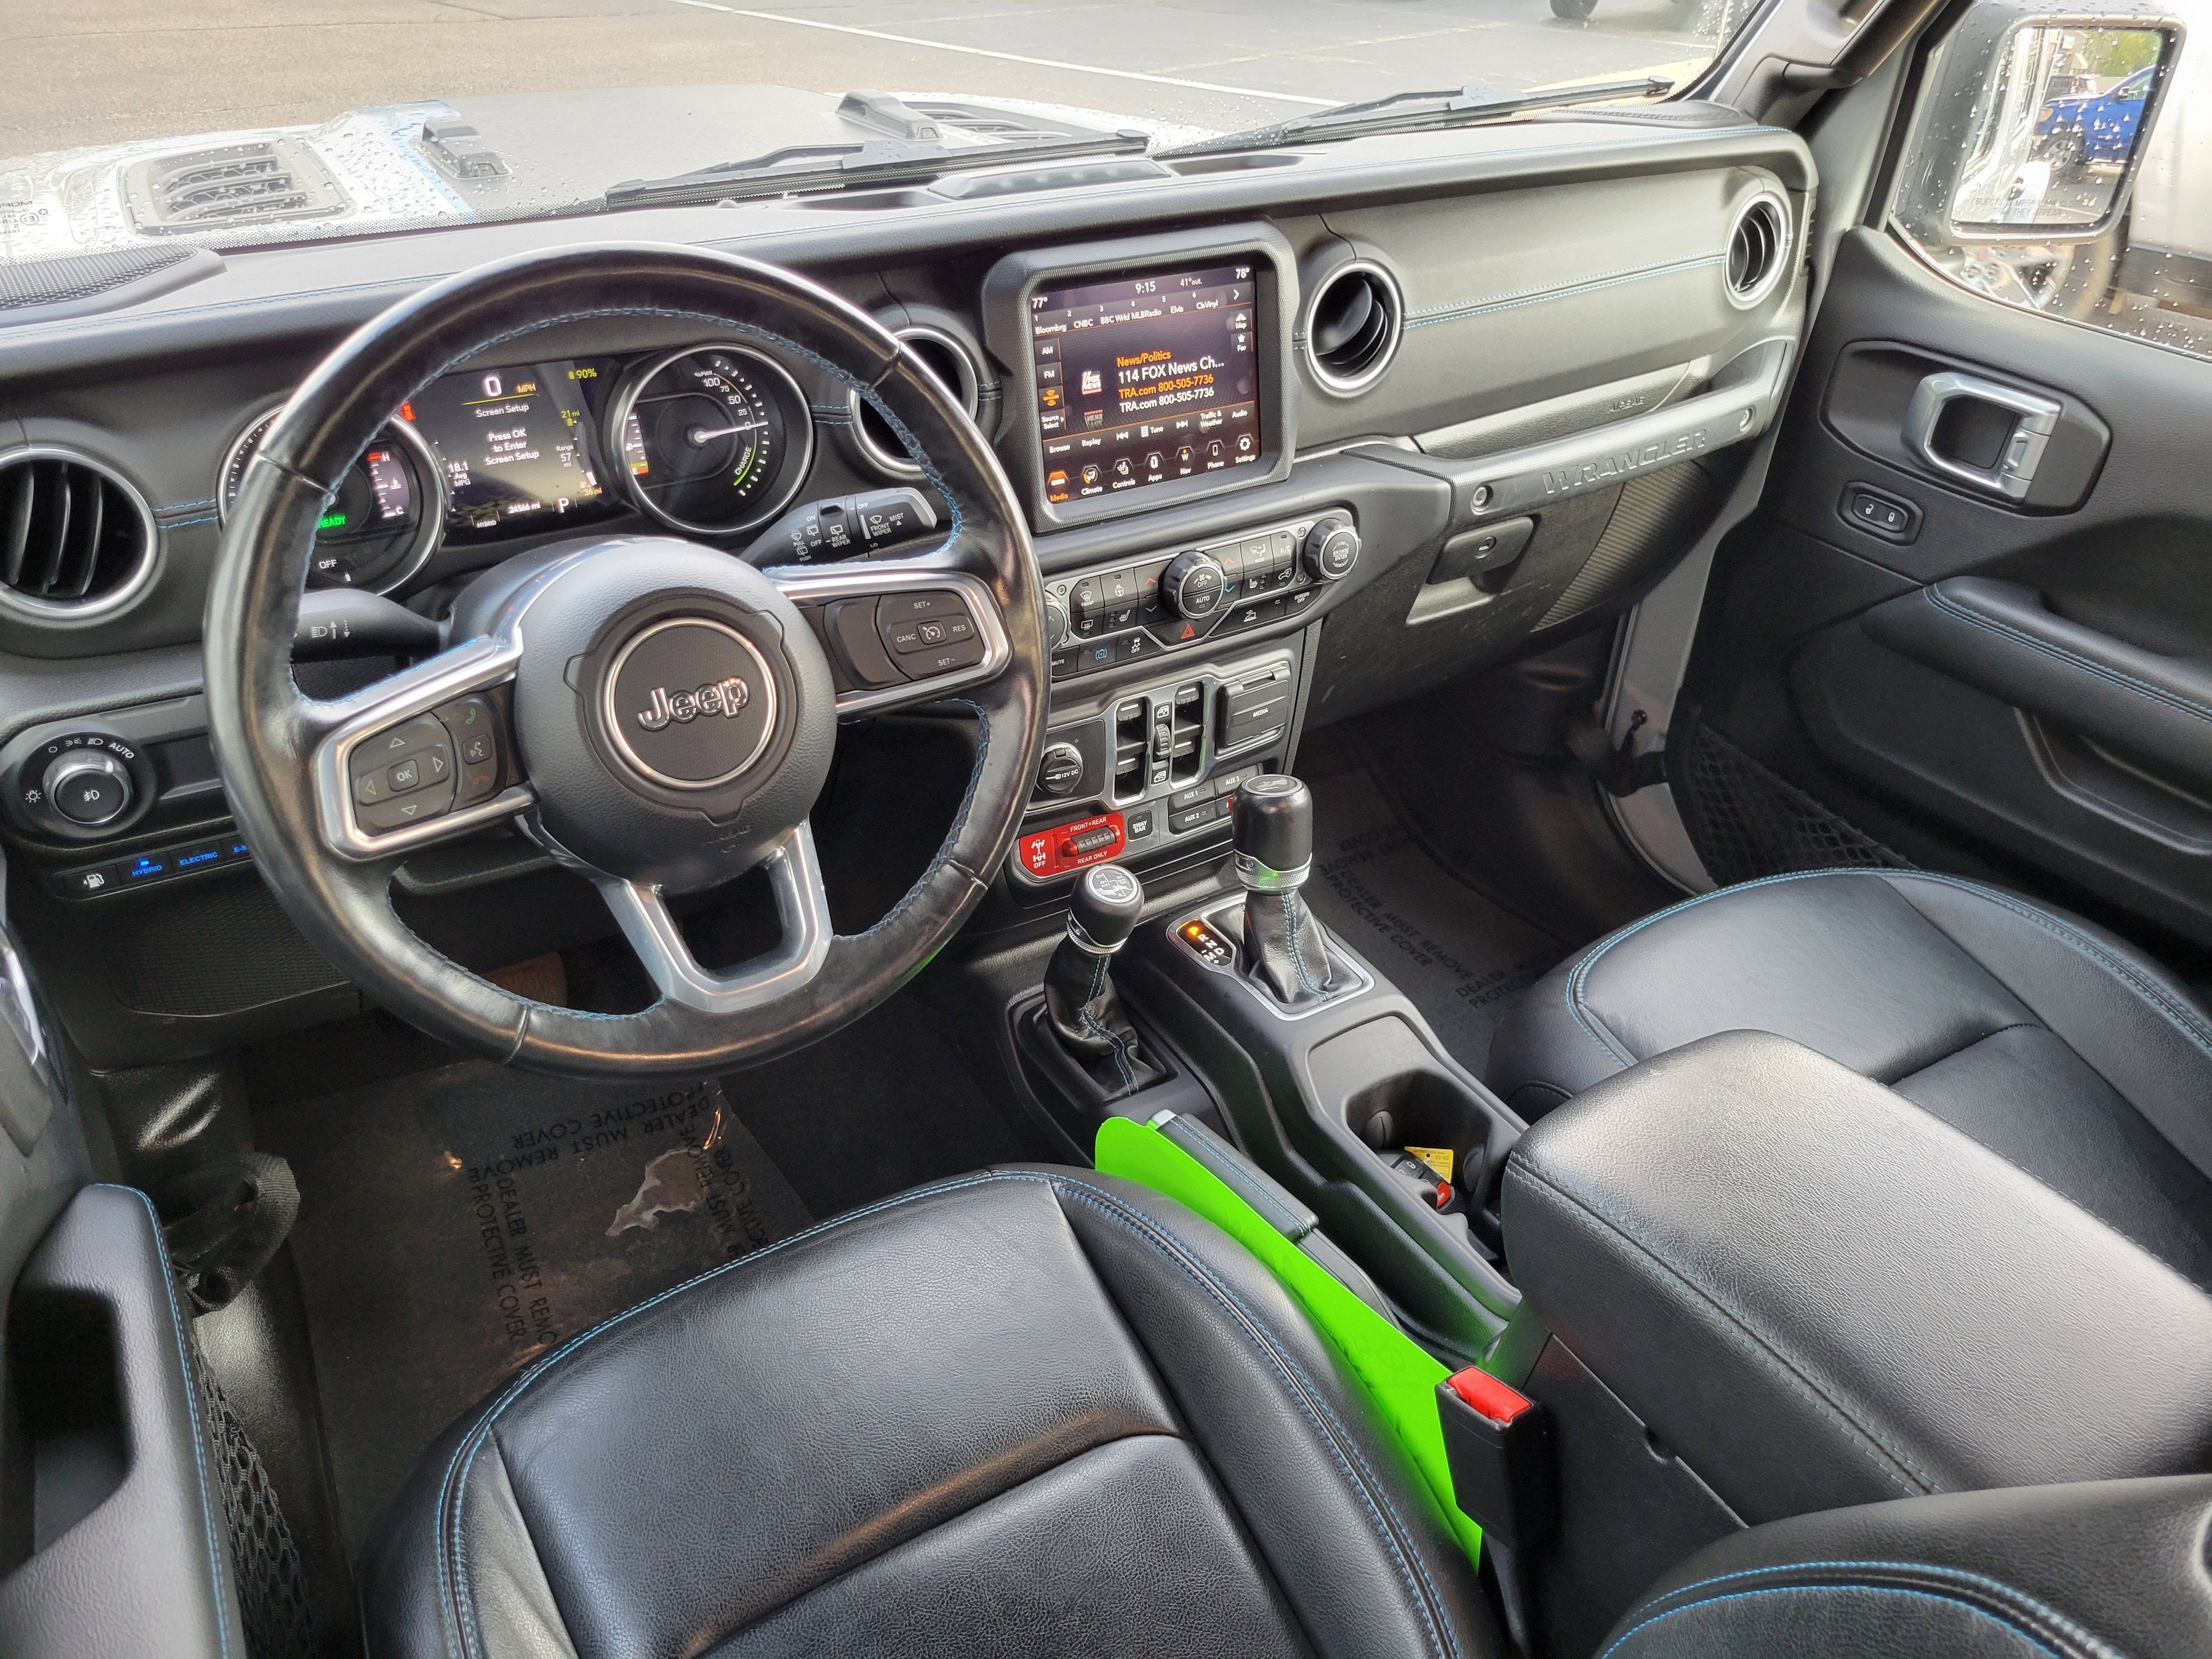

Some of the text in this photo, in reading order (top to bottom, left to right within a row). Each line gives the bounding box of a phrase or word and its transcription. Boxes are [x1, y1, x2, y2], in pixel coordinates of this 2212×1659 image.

[1031, 268, 1250, 309] 77° 9:15 78°
[1196, 299, 1218, 309] ClsVinyl
[1131, 308, 1162, 320] MLBRadio
[1170, 305, 1184, 314] Elvis
[1074, 319, 1093, 328] CNBC
[1101, 313, 1130, 325] BBC Wrld
[1035, 323, 1067, 335] Bloombrg
[1235, 321, 1246, 330] Map
[1042, 346, 1053, 356] AM
[1117, 351, 1171, 368] News/Politics
[576, 368, 597, 379] 90%
[1044, 370, 1055, 379] FM
[1119, 371, 1139, 384] 114
[1142, 366, 1166, 380] FOX
[1169, 363, 1198, 377] News
[484, 376, 536, 396] 0 MPH
[703, 377, 720, 387] 100
[1119, 374, 1214, 399] TRA.com 800-505-7736
[729, 396, 741, 404] 50
[1119, 388, 1215, 413] TRA.com 800-505-7736
[476, 404, 529, 417] Screen Setup
[1232, 410, 1248, 418] Audio
[1042, 415, 1059, 423] Source
[1200, 412, 1216, 421] Traffic
[1200, 419, 1222, 428] Weather
[488, 428, 527, 442] Press OK
[1150, 426, 1163, 434] Tune
[494, 441, 527, 453] to Enter
[1082, 438, 1101, 448] Replay
[1049, 444, 1070, 453] Browse
[382, 454, 390, 463] H
[486, 450, 540, 466] Screen Setup
[561, 453, 571, 462] 57
[734, 447, 752, 476] CHARGE
[1235, 454, 1255, 464] Settings
[1542, 428, 1707, 494] WRANGLER
[448, 462, 469, 473] 18.1
[1207, 460, 1224, 469] Phone
[454, 478, 471, 487] MPG
[1148, 473, 1163, 482] Apps
[1113, 479, 1136, 489] Controls
[1081, 486, 1103, 495] Climate
[1049, 493, 1069, 501] Media
[509, 504, 531, 514] 24566
[558, 498, 569, 514] P
[889, 513, 904, 522] MIST
[477, 520, 496, 528] HYBRID
[870, 523, 889, 532] FRONT
[872, 528, 891, 537] WIPER
[832, 534, 848, 543] REAR
[832, 539, 851, 548] WIPER
[1280, 545, 1291, 553] A/C
[1333, 548, 1348, 556] BROWSE
[319, 559, 338, 569] OFF
[1195, 595, 1210, 603] AUTO
[1294, 591, 1310, 601] SCREEN
[897, 634, 916, 643] CANC
[637, 676, 749, 731] Jeep
[1252, 708, 1268, 718] MEDIA
[109, 742, 134, 759] AUTO
[397, 769, 413, 781] OK
[1061, 768, 1079, 780] 12V DC
[1225, 776, 1235, 786] AUX
[1183, 790, 1198, 800] AUX 1
[1184, 814, 1195, 823] AUX
[1132, 820, 1147, 830] SWAY
[1134, 826, 1146, 834] BAR
[179, 851, 218, 866] ELECTRIC
[1077, 850, 1108, 864] REAR ONLY
[132, 864, 162, 877] HYBRID
[1197, 934, 1209, 942] R
[1205, 939, 1218, 949] N
[1384, 912, 1421, 938] MUST
[1420, 939, 1475, 981] REMOVE
[1214, 947, 1224, 956] D
[1390, 934, 1433, 966] COVER
[1203, 952, 1217, 961] M
[468, 1095, 711, 1182] DEALER MUST REMOVE
[512, 1120, 583, 1150] COVER
[713, 1146, 746, 1196] COVER
[497, 1176, 543, 1289] DEALER MUST
[471, 1181, 528, 1340] PROTECTIVE COVER
